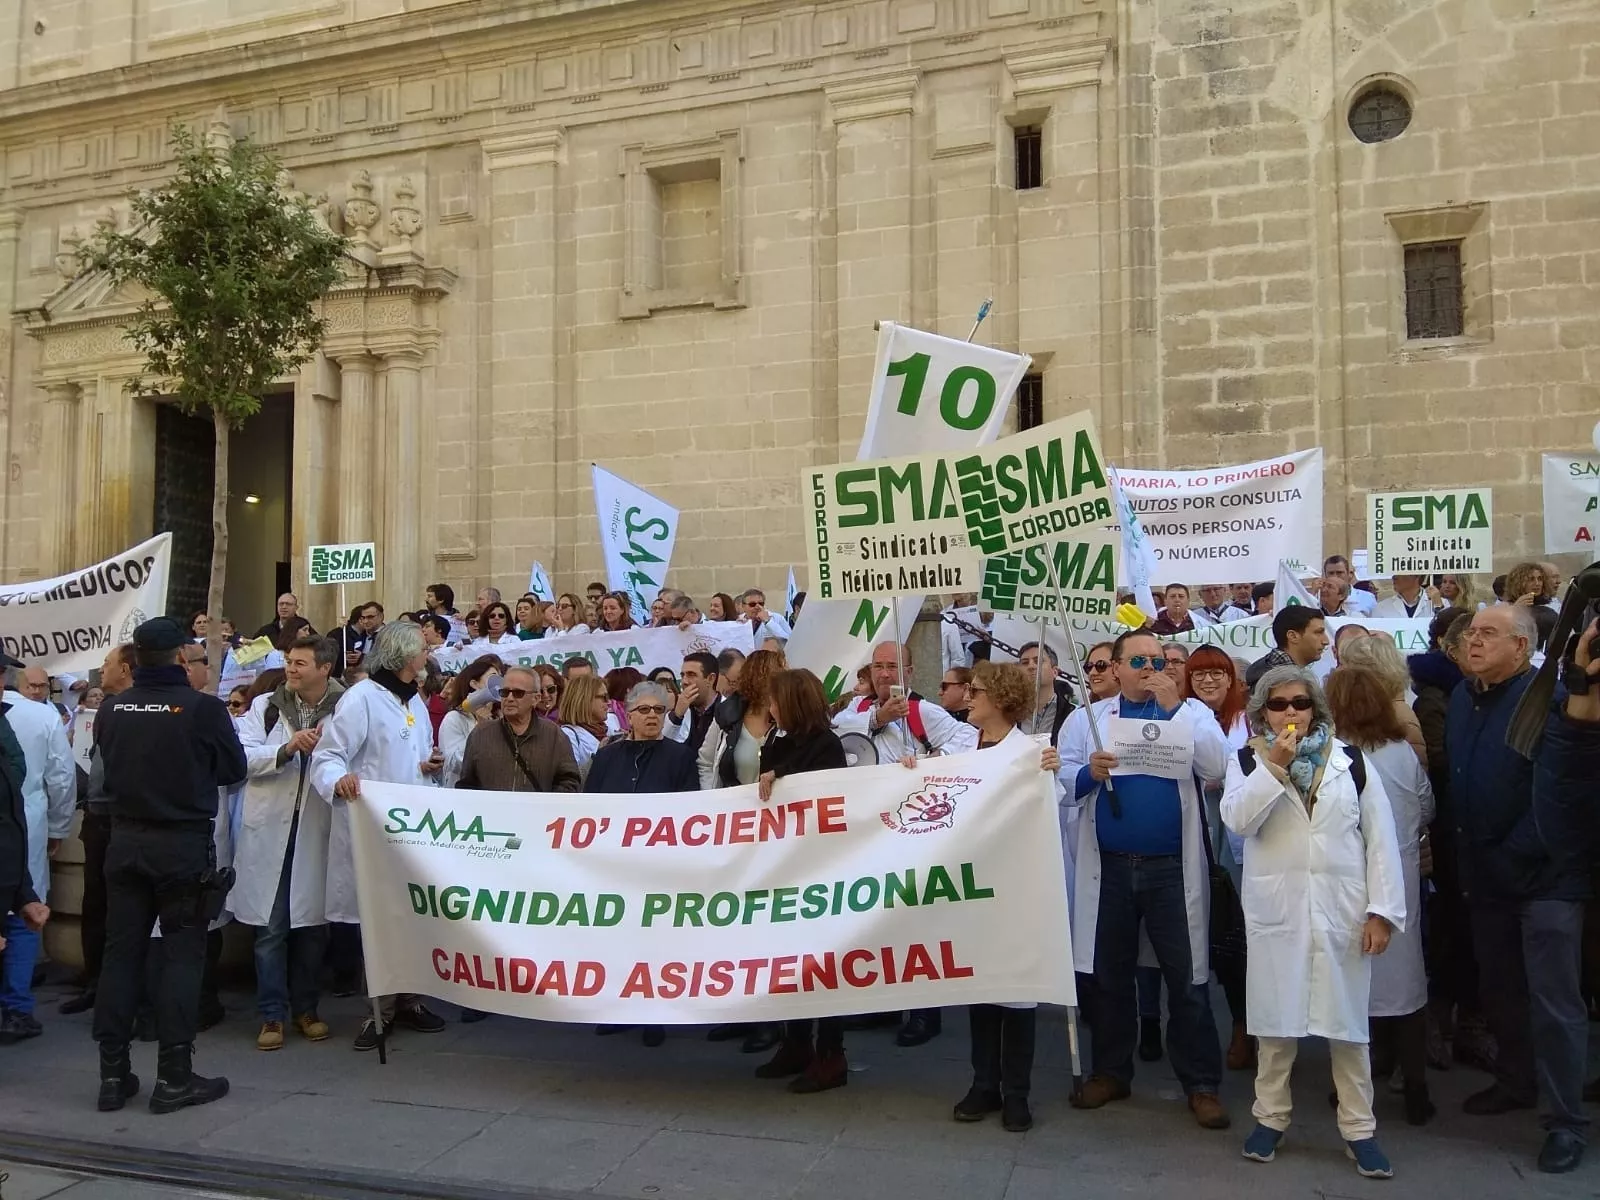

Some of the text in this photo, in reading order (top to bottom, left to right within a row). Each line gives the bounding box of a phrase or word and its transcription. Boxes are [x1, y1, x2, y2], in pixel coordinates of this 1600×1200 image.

[887, 352, 997, 431] 10
[996, 429, 1107, 514] SMA
[1187, 477, 1208, 487] LO
[1214, 461, 1295, 485] PRIMERO
[835, 459, 960, 529] SMA
[1128, 488, 1302, 511] NUTOS POR CONSULTA
[1392, 493, 1489, 532] SMA
[860, 532, 948, 561] Sindicato
[1169, 545, 1250, 561] NÚMEROS
[1407, 536, 1471, 552] Sindicato
[328, 548, 374, 570] SMA
[1021, 541, 1115, 592] SMA
[1392, 555, 1480, 571] Médico Andaluz
[842, 563, 963, 594] Médico Andaluz
[2, 625, 112, 659] DAD DIGNA
[606, 646, 645, 668] YA
[113, 703, 171, 713] POLICIA
[923, 775, 983, 785] Plataforma
[384, 807, 485, 843] SMA
[621, 796, 848, 848] PACIENTE
[908, 823, 945, 835] Huelva
[387, 838, 507, 853] Sindicato Médico Andaluz
[467, 849, 512, 860] Huelva
[407, 862, 995, 928] DIGNIDAD PROFESIONAL
[431, 940, 974, 999] CALIDAD ASISTENCIAL
